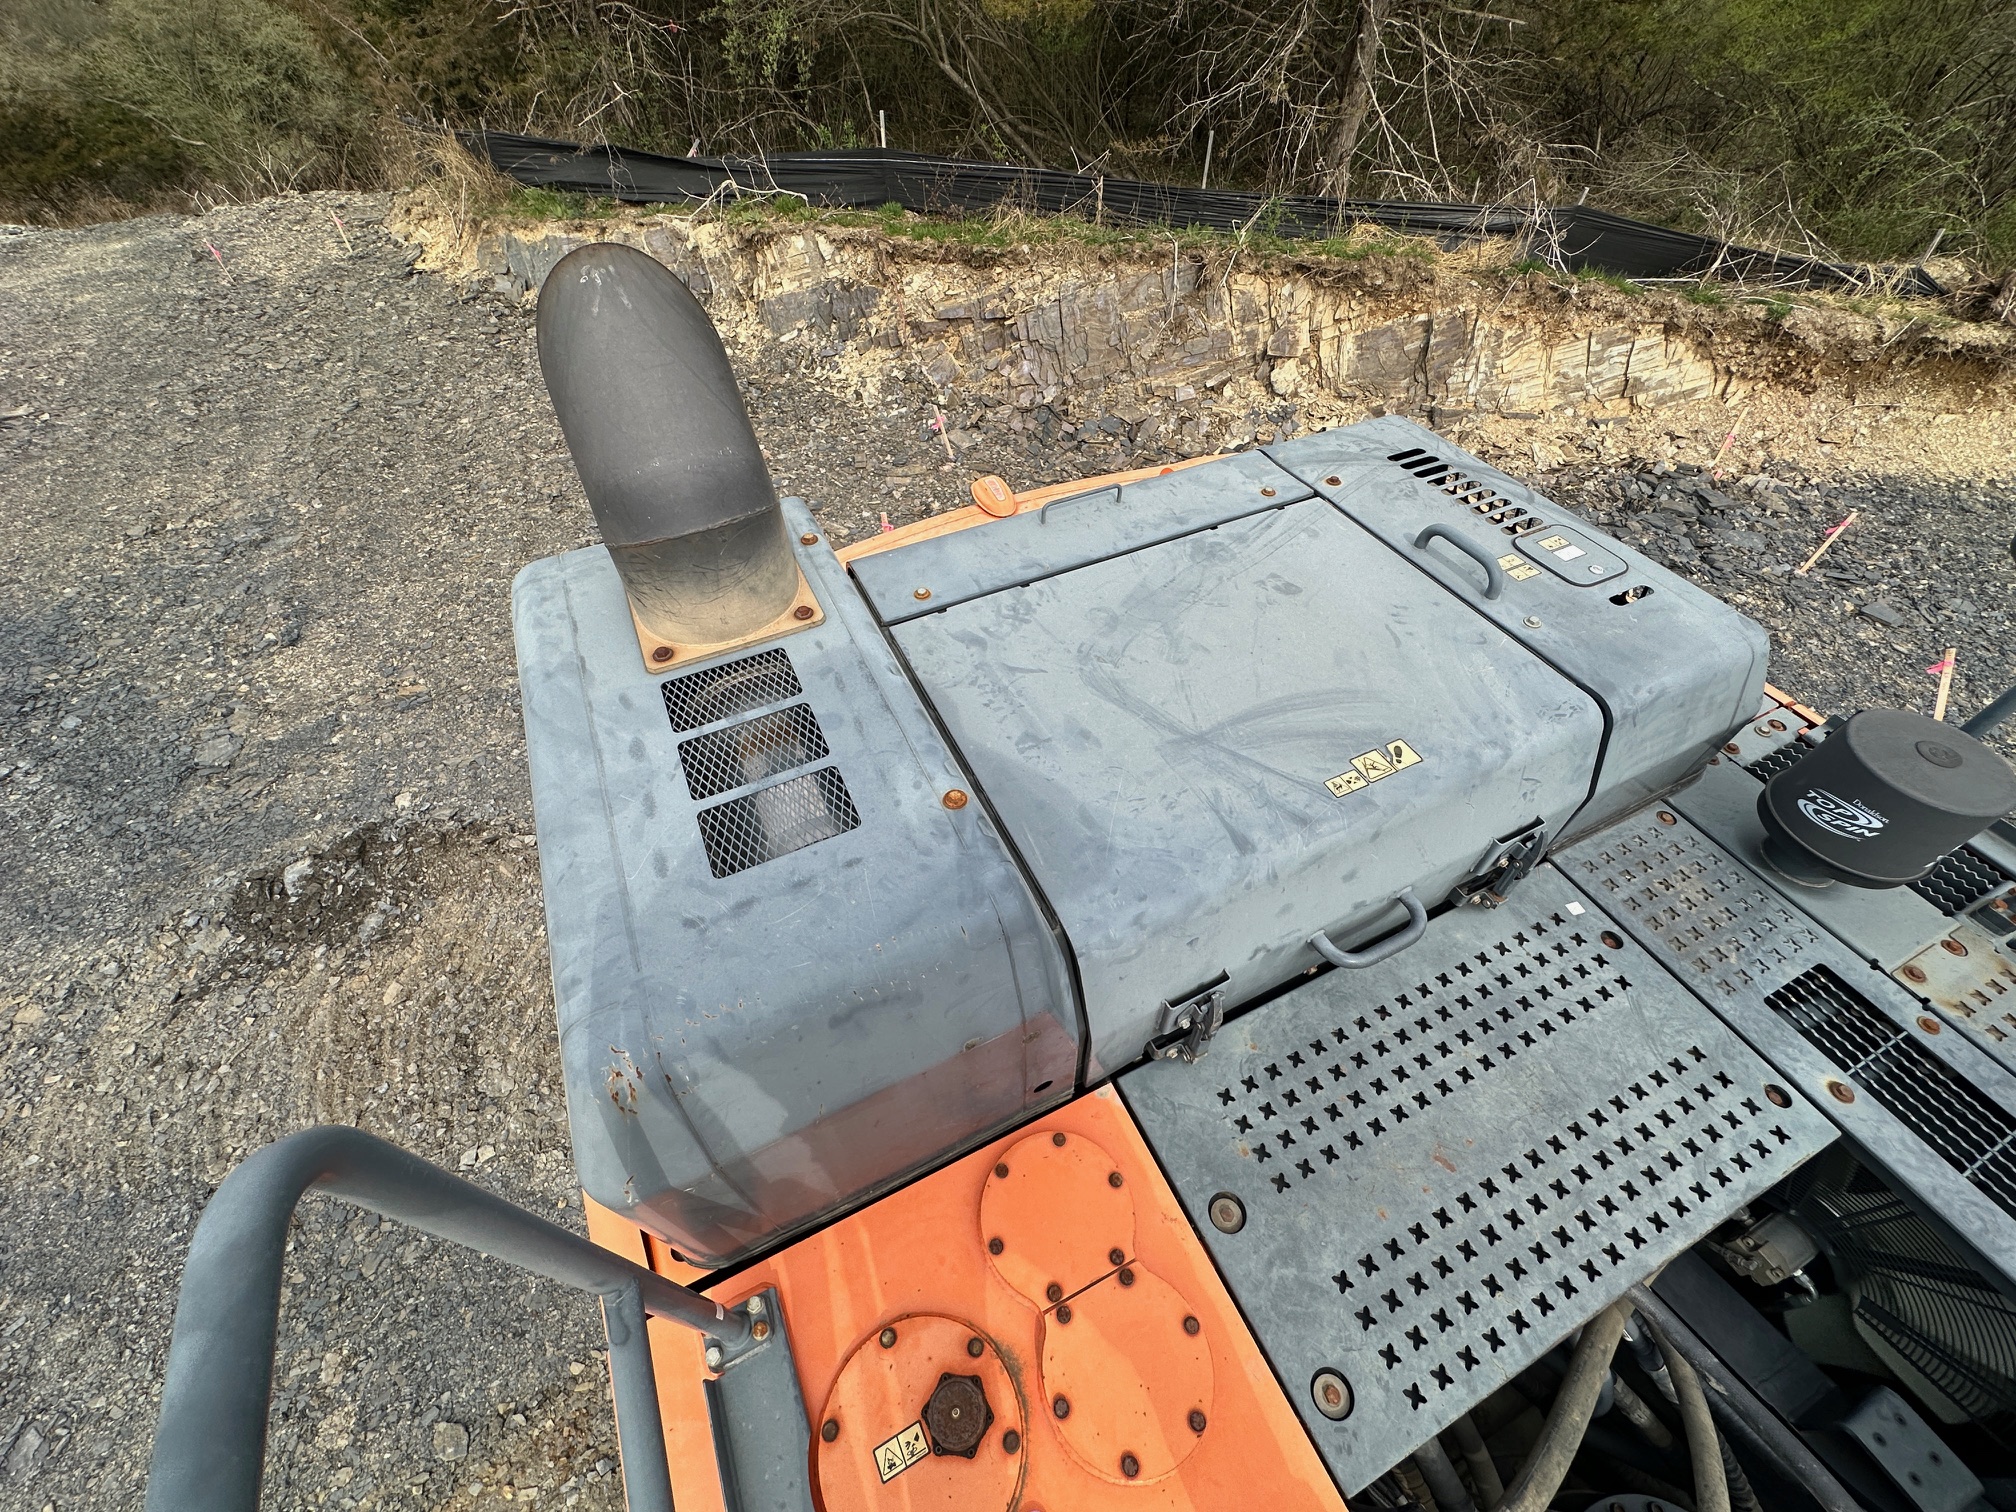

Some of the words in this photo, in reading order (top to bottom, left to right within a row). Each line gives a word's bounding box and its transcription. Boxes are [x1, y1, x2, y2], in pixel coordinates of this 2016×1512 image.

[1806, 789, 1854, 816] TOP
[1852, 799, 1890, 824] Donaldson
[1816, 813, 1881, 837] SPIN
